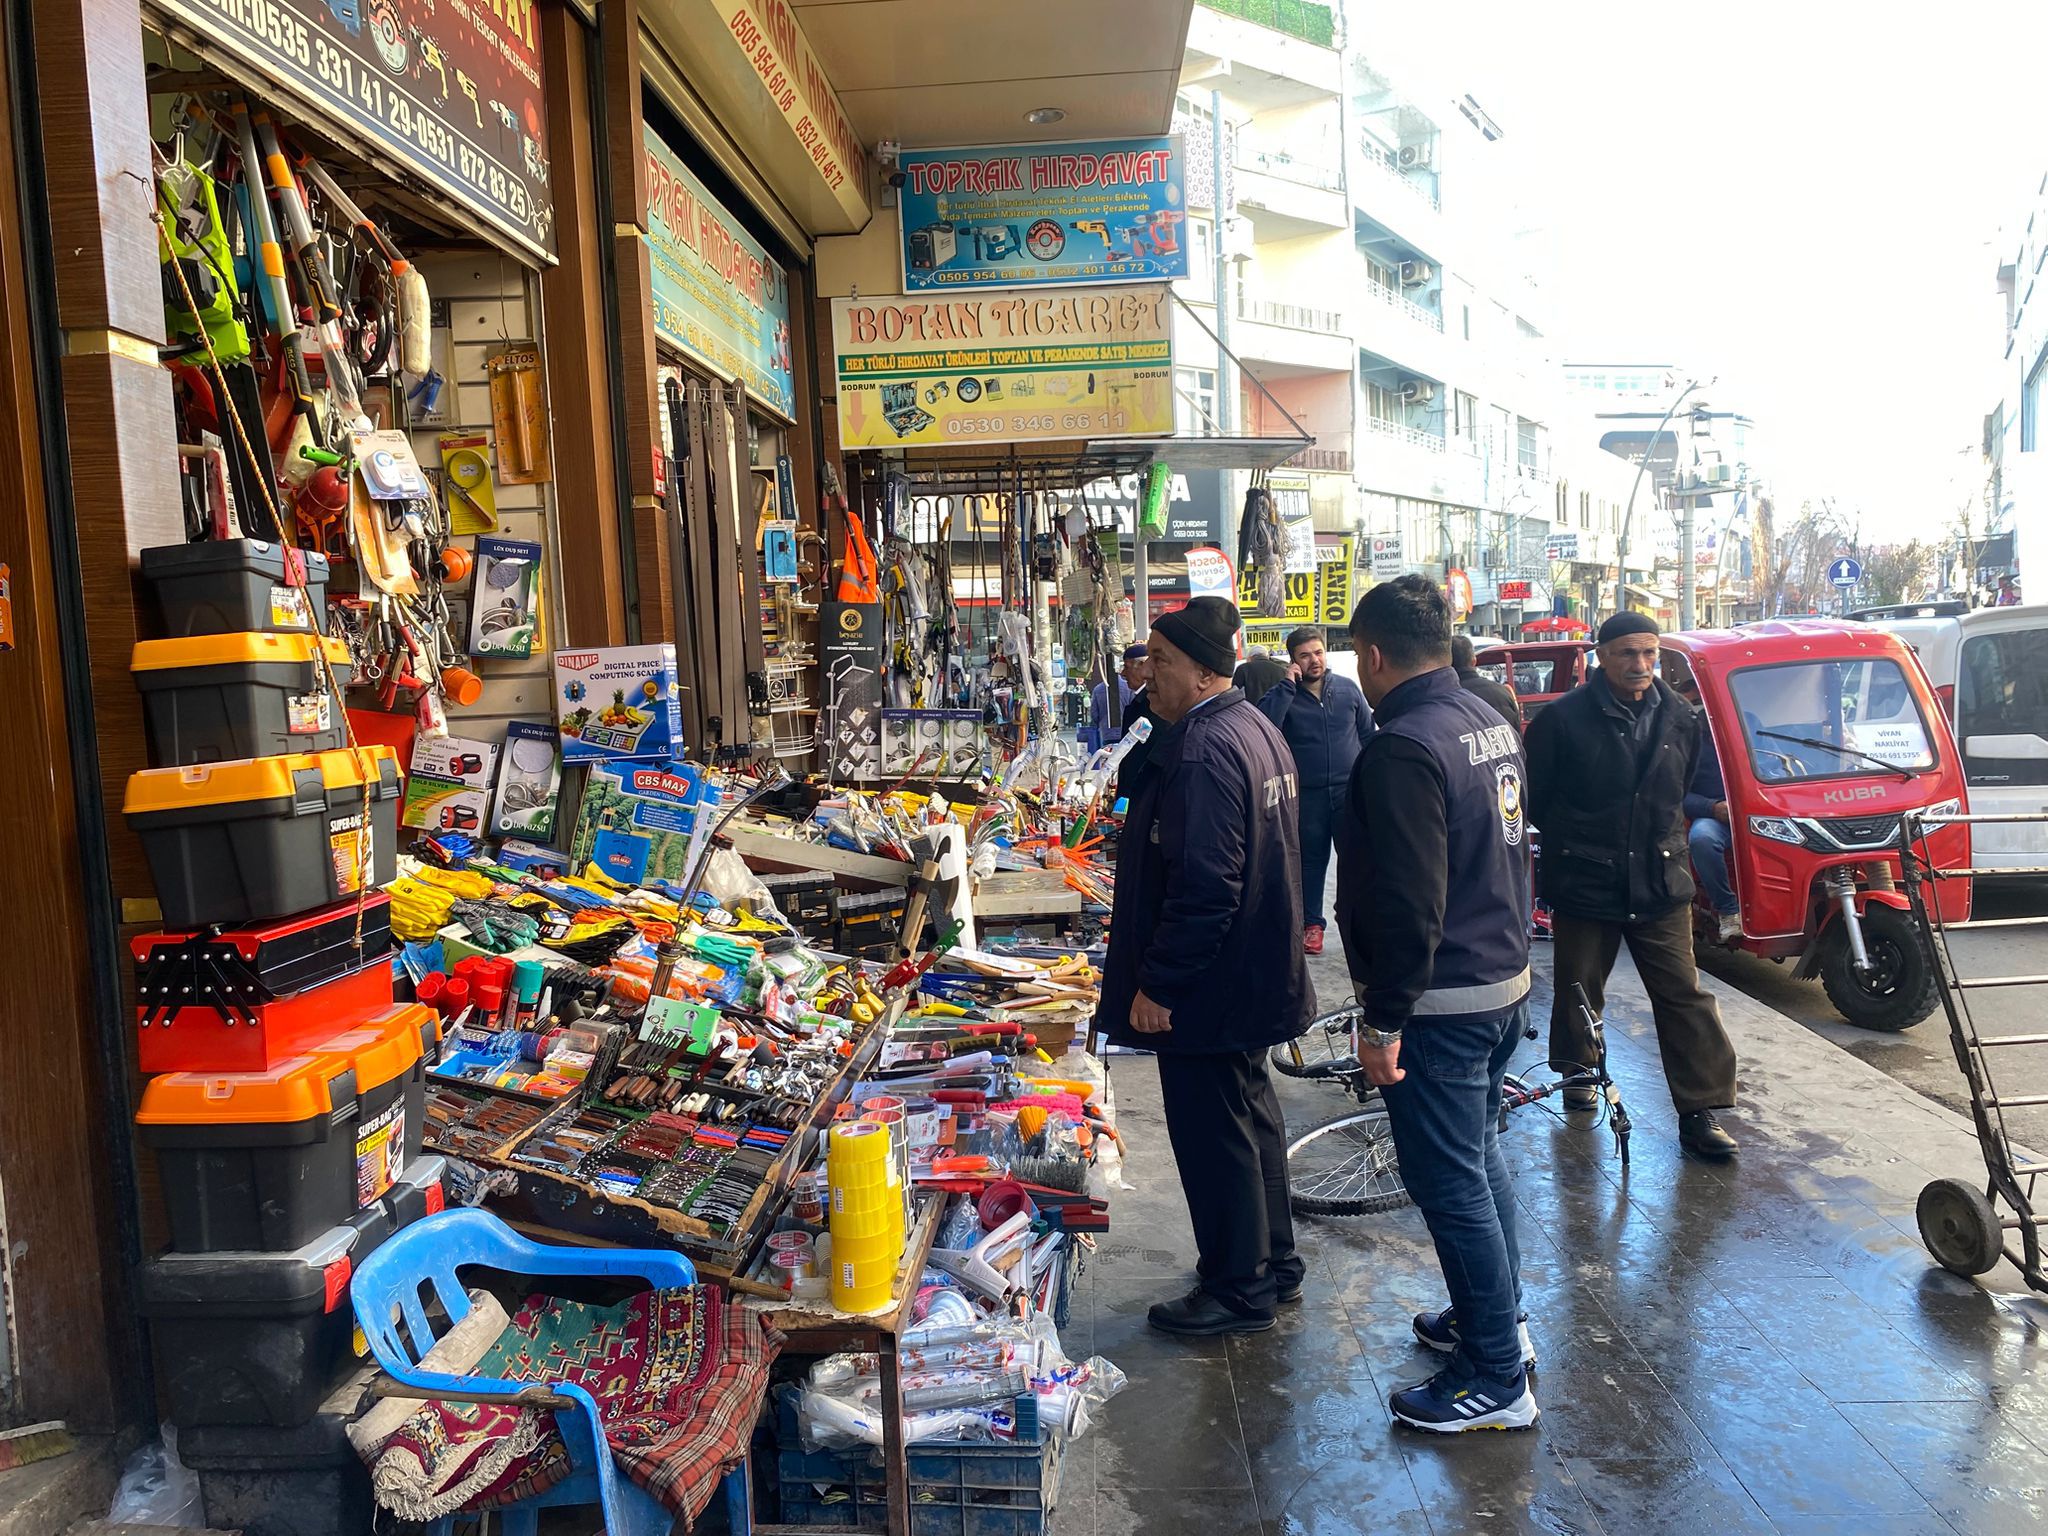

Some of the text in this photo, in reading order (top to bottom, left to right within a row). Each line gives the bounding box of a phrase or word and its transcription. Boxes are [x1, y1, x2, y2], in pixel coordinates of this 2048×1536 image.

[471, 10, 498, 48] TESİSAT
[499, 38, 541, 89] MALZEMELERİ
[730, 9, 844, 191] 0505 954 60 06 0532 401 46 72
[316, 38, 354, 98] 331
[360, 70, 383, 118] 41
[459, 143, 487, 191] 872
[489, 166, 507, 205] 83
[509, 183, 526, 218] 25
[908, 150, 1172, 197] TOPRAK HIRDAVAT
[1090, 205, 1100, 214] ve
[1103, 203, 1150, 214] Perakende
[697, 199, 764, 314] HIRDAVAT
[939, 271, 970, 282] 0505
[973, 270, 996, 280] 954
[1083, 264, 1107, 274] 401
[1110, 264, 1126, 273] 46
[1129, 263, 1145, 272] 72
[848, 302, 983, 344] BOTAN
[504, 353, 535, 365] ELTOS
[663, 305, 685, 339] 954
[771, 385, 780, 405] 72
[845, 358, 865, 371] HER
[866, 354, 896, 370] TÜRLÜ
[897, 356, 944, 369] HIRDAVAT
[946, 349, 991, 366] ÜRÜNLERİ
[992, 350, 1029, 365] TOPTAN
[1045, 347, 1099, 361] PERAKENDE
[1100, 345, 1126, 361] SATIŞ
[1134, 370, 1169, 379] BODRUM
[841, 383, 876, 391] BODRUM
[947, 411, 1124, 435] 0530 346 66 11
[1386, 540, 1400, 550] DİŞ
[1374, 551, 1402, 560] HEKİMİ
[1149, 578, 1176, 586] HIRDAVAT
[1326, 544, 1348, 621] ANKO
[558, 653, 598, 670] DINAMIC
[604, 660, 660, 671] DIGITAL PRICE
[589, 669, 660, 680] COMPUTING SCALE
[1877, 730, 1902, 738] VİYAN
[1875, 740, 1910, 748] NAKLİYAT
[1902, 751, 1920, 759] 5755
[412, 778, 427, 786] GOLD
[637, 775, 686, 794] CBS MAX
[638, 789, 660, 798] GARDEN
[1824, 785, 1887, 804] KUBA
[330, 815, 362, 832] SUPER-BAG
[513, 819, 547, 833] beyazsu
[358, 1109, 393, 1140] SUPER-BAG
[358, 1140, 368, 1156] 22
